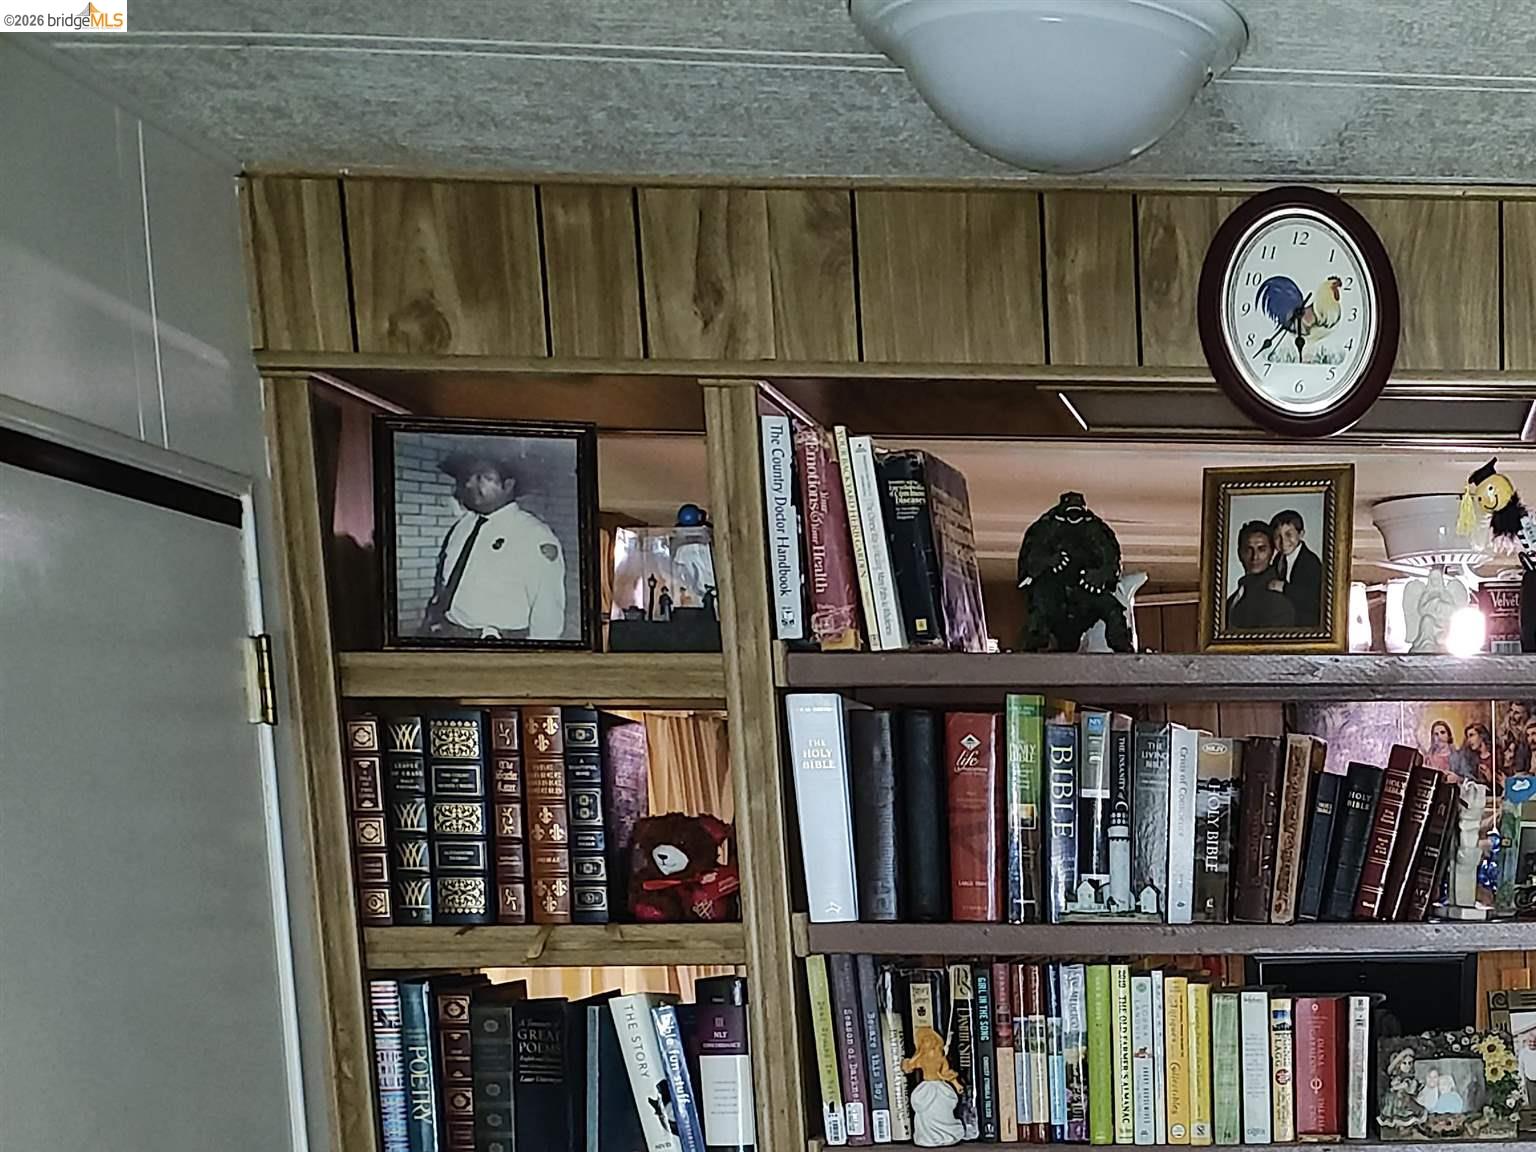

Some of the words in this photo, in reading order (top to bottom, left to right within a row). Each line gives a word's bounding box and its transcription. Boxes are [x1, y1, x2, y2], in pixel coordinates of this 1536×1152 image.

[1292, 232, 1310, 245] 12
[1261, 245, 1276, 259] 11
[1328, 248, 1335, 262] 1
[1245, 272, 1262, 286] 10
[1344, 277, 1353, 290] 2
[1242, 304, 1251, 316] 9
[1348, 308, 1358, 321] 3
[1246, 333, 1255, 346] 8
[1344, 338, 1354, 351] 4
[1263, 364, 1272, 376] 7
[1326, 368, 1336, 380] 5
[1294, 380, 1304, 393] 6
[770, 425, 784, 444] The
[837, 430, 846, 457] YOUR
[771, 448, 786, 492] Country
[841, 458, 856, 508] BACKYARD
[774, 497, 787, 533] Doctor
[805, 441, 821, 511] Emotions
[813, 545, 827, 593] Health
[849, 510, 860, 538] HERB
[776, 537, 792, 596] Handbook
[854, 539, 867, 578] GARDEN
[1490, 592, 1520, 608] Velvet
[803, 749, 832, 758] HOLY
[956, 751, 979, 769] life
[802, 760, 836, 768] BIBLE
[1118, 754, 1126, 791] INSANITY
[1051, 745, 1073, 838] BIBLE
[1349, 790, 1372, 800] HOLY
[1207, 784, 1222, 822] HOLY
[1347, 799, 1369, 810] BIBLE
[1205, 826, 1219, 873] BIBLE
[977, 977, 986, 994] GIRL
[979, 995, 986, 1004] IN
[1118, 995, 1127, 1013] THE
[979, 1005, 987, 1019] THE
[843, 1009, 854, 1045] Season
[868, 1012, 877, 1048] Beware
[980, 1020, 989, 1041] SONG
[1118, 1015, 1128, 1033] OLD
[623, 1004, 635, 1030] THE
[630, 1037, 650, 1079] STORY
[668, 1050, 682, 1071] fun
[872, 1054, 881, 1077] this
[1120, 1036, 1129, 1079] FARMER'S
[408, 1046, 432, 1125] POETRY
[873, 1082, 883, 1101] Boy
[1122, 1081, 1130, 1123] ALMANAC
